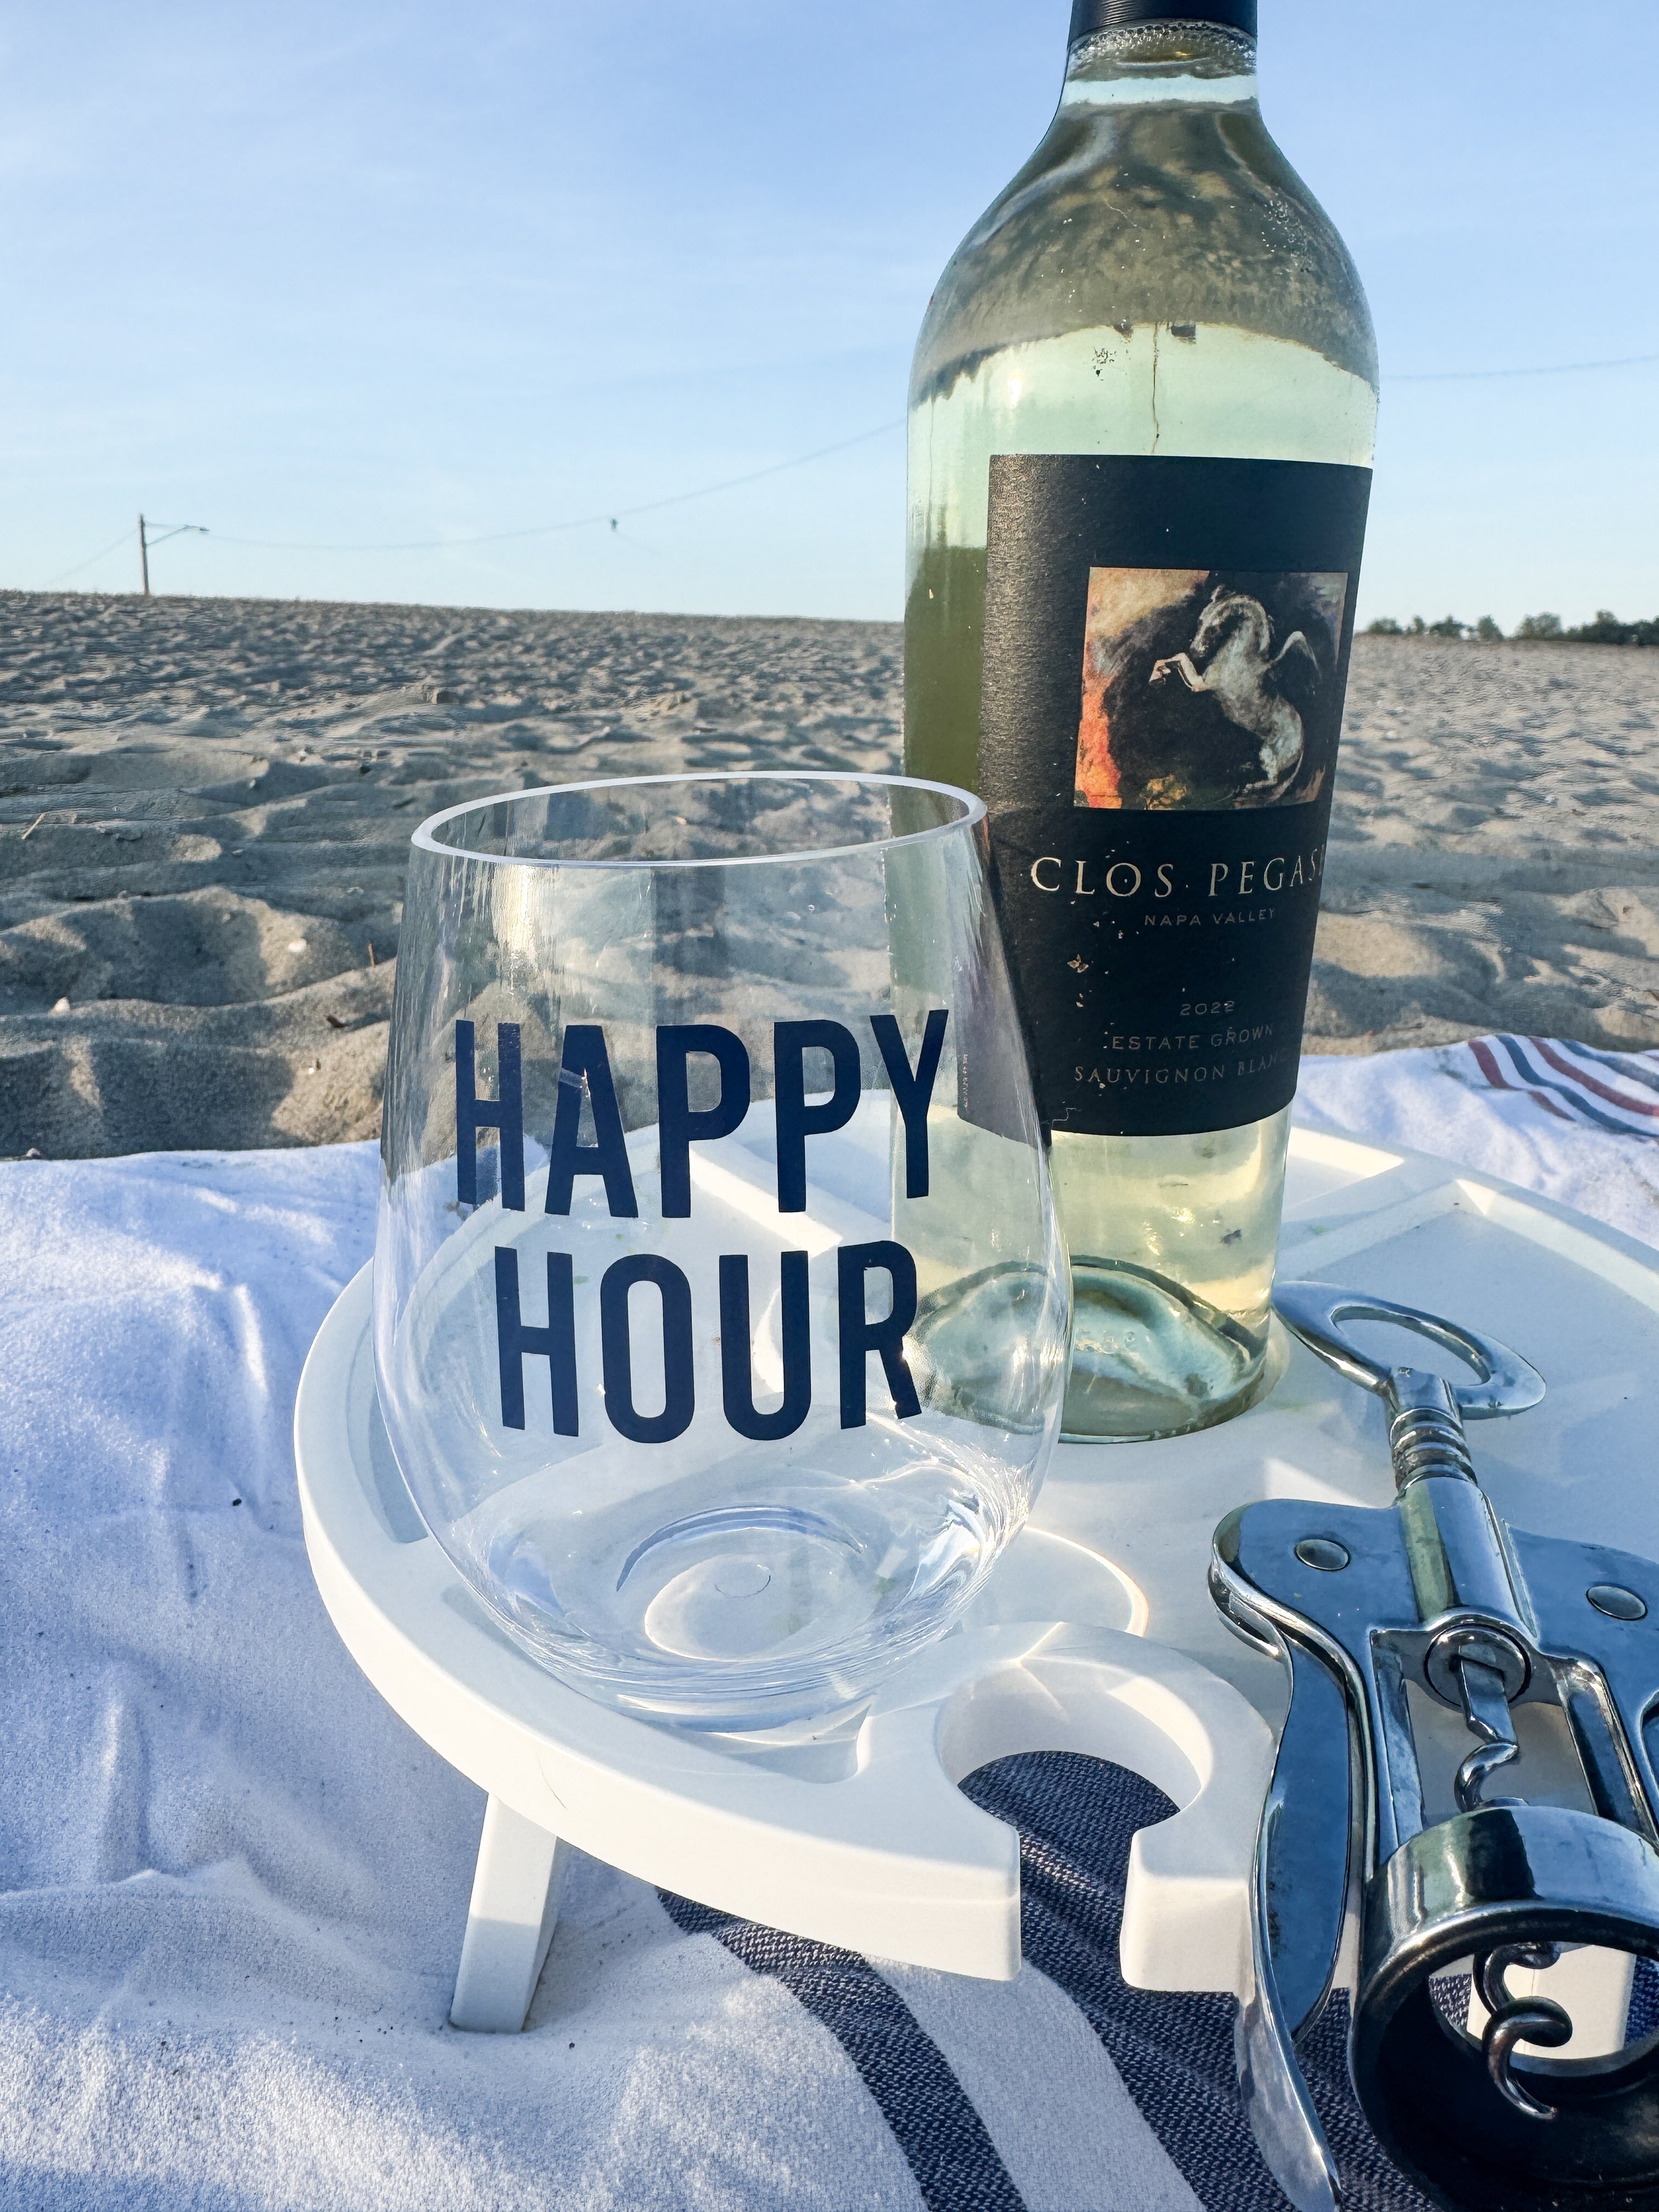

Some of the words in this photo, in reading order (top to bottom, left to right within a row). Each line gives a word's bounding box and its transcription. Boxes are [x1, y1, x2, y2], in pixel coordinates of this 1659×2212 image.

[1030, 856, 1173, 898] CLOS
[1144, 913, 1201, 927] NAPA
[1212, 907, 1276, 924] VALLEY
[1112, 1035, 1200, 1050] ESTATE
[1211, 1023, 1273, 1047] GROWN
[1074, 1064, 1224, 1085] SAUVIGNON
[455, 1009, 949, 1218] HAPPY
[494, 1240, 922, 1444] HOUR
